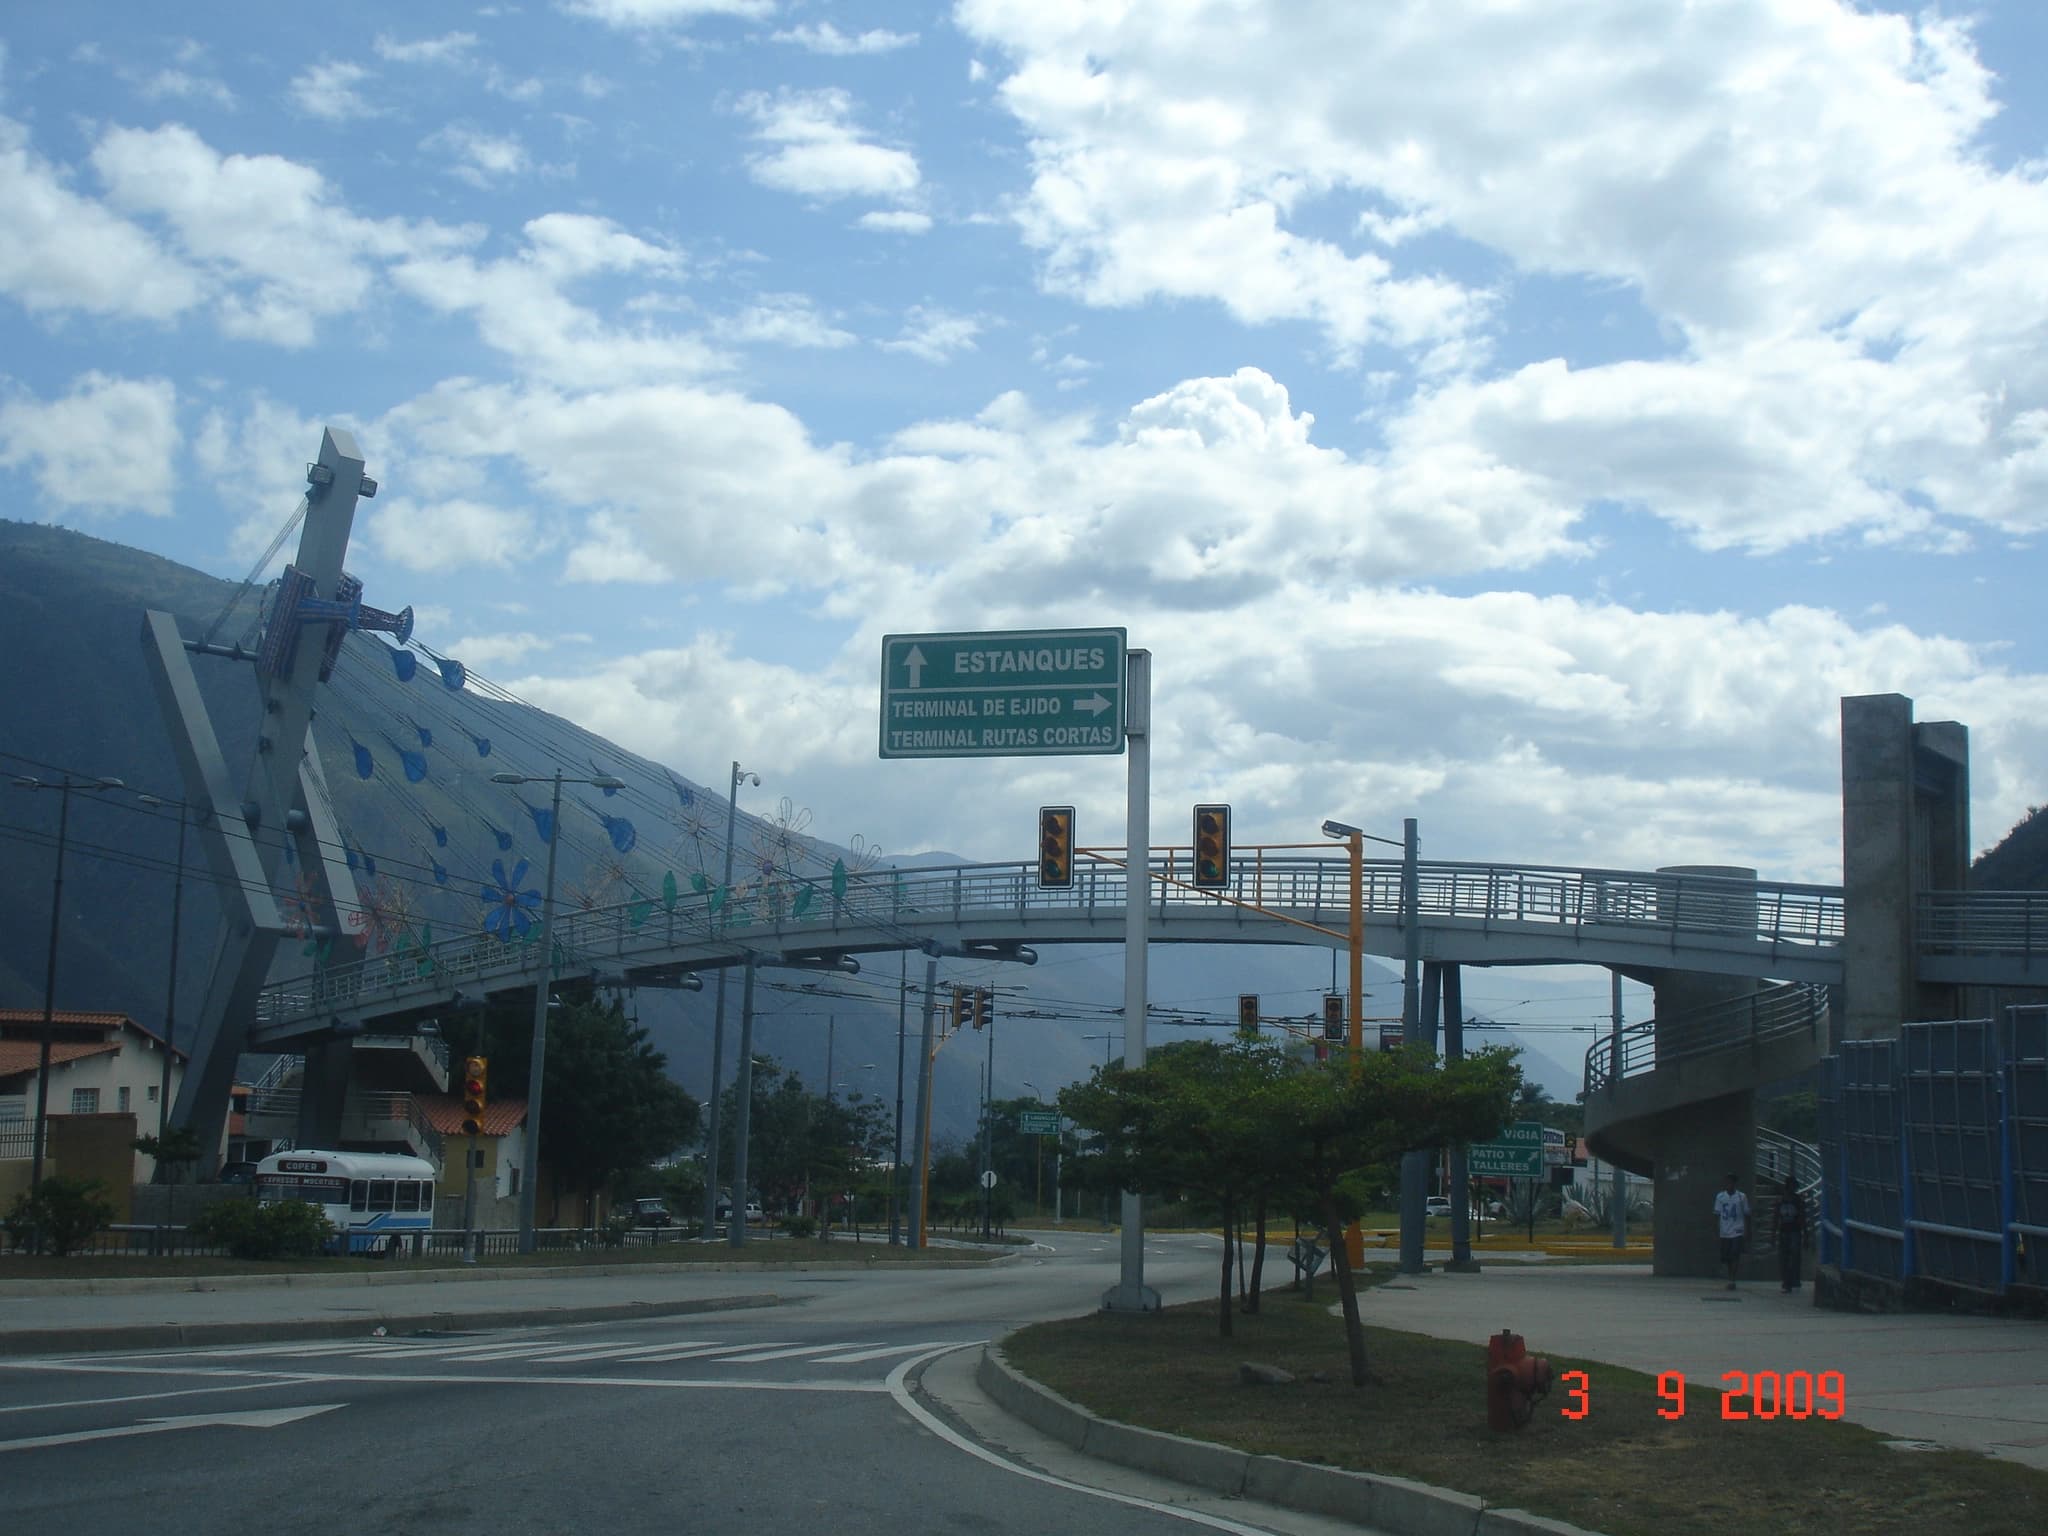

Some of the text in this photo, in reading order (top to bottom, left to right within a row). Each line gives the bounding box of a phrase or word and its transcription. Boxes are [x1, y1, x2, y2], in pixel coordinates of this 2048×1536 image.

[954, 647, 1105, 673] ESTANQUES
[892, 697, 1062, 718] TERMINAL DE EJIDO
[891, 726, 1112, 748] TERMINAL RUTAS CORTAS
[1472, 1149, 1516, 1160] PATIO Y
[1471, 1160, 1530, 1171] TALLERES
[1722, 1202, 1738, 1222] 54
